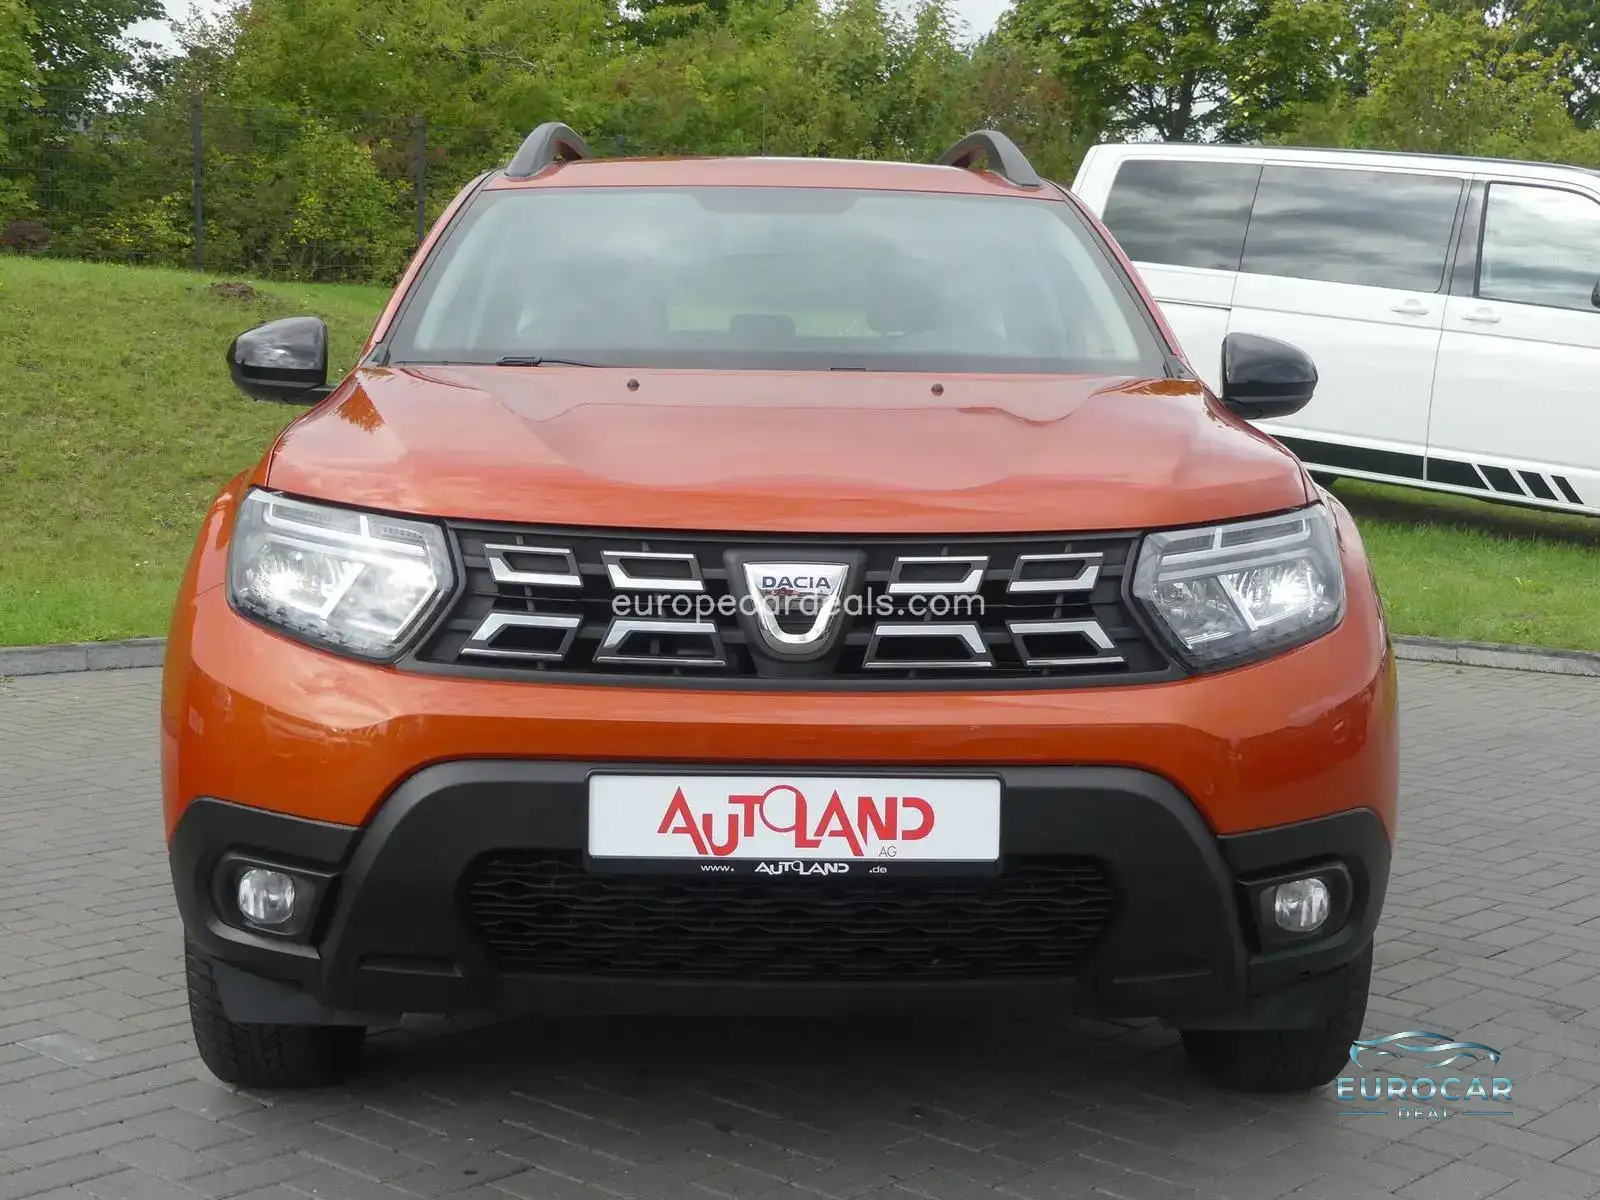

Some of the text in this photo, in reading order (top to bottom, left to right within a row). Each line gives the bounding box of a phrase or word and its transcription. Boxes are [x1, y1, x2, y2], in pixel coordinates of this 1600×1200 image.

[762, 576, 831, 590] DACIA
[878, 845, 897, 858] AG
[869, 864, 887, 873] .de
